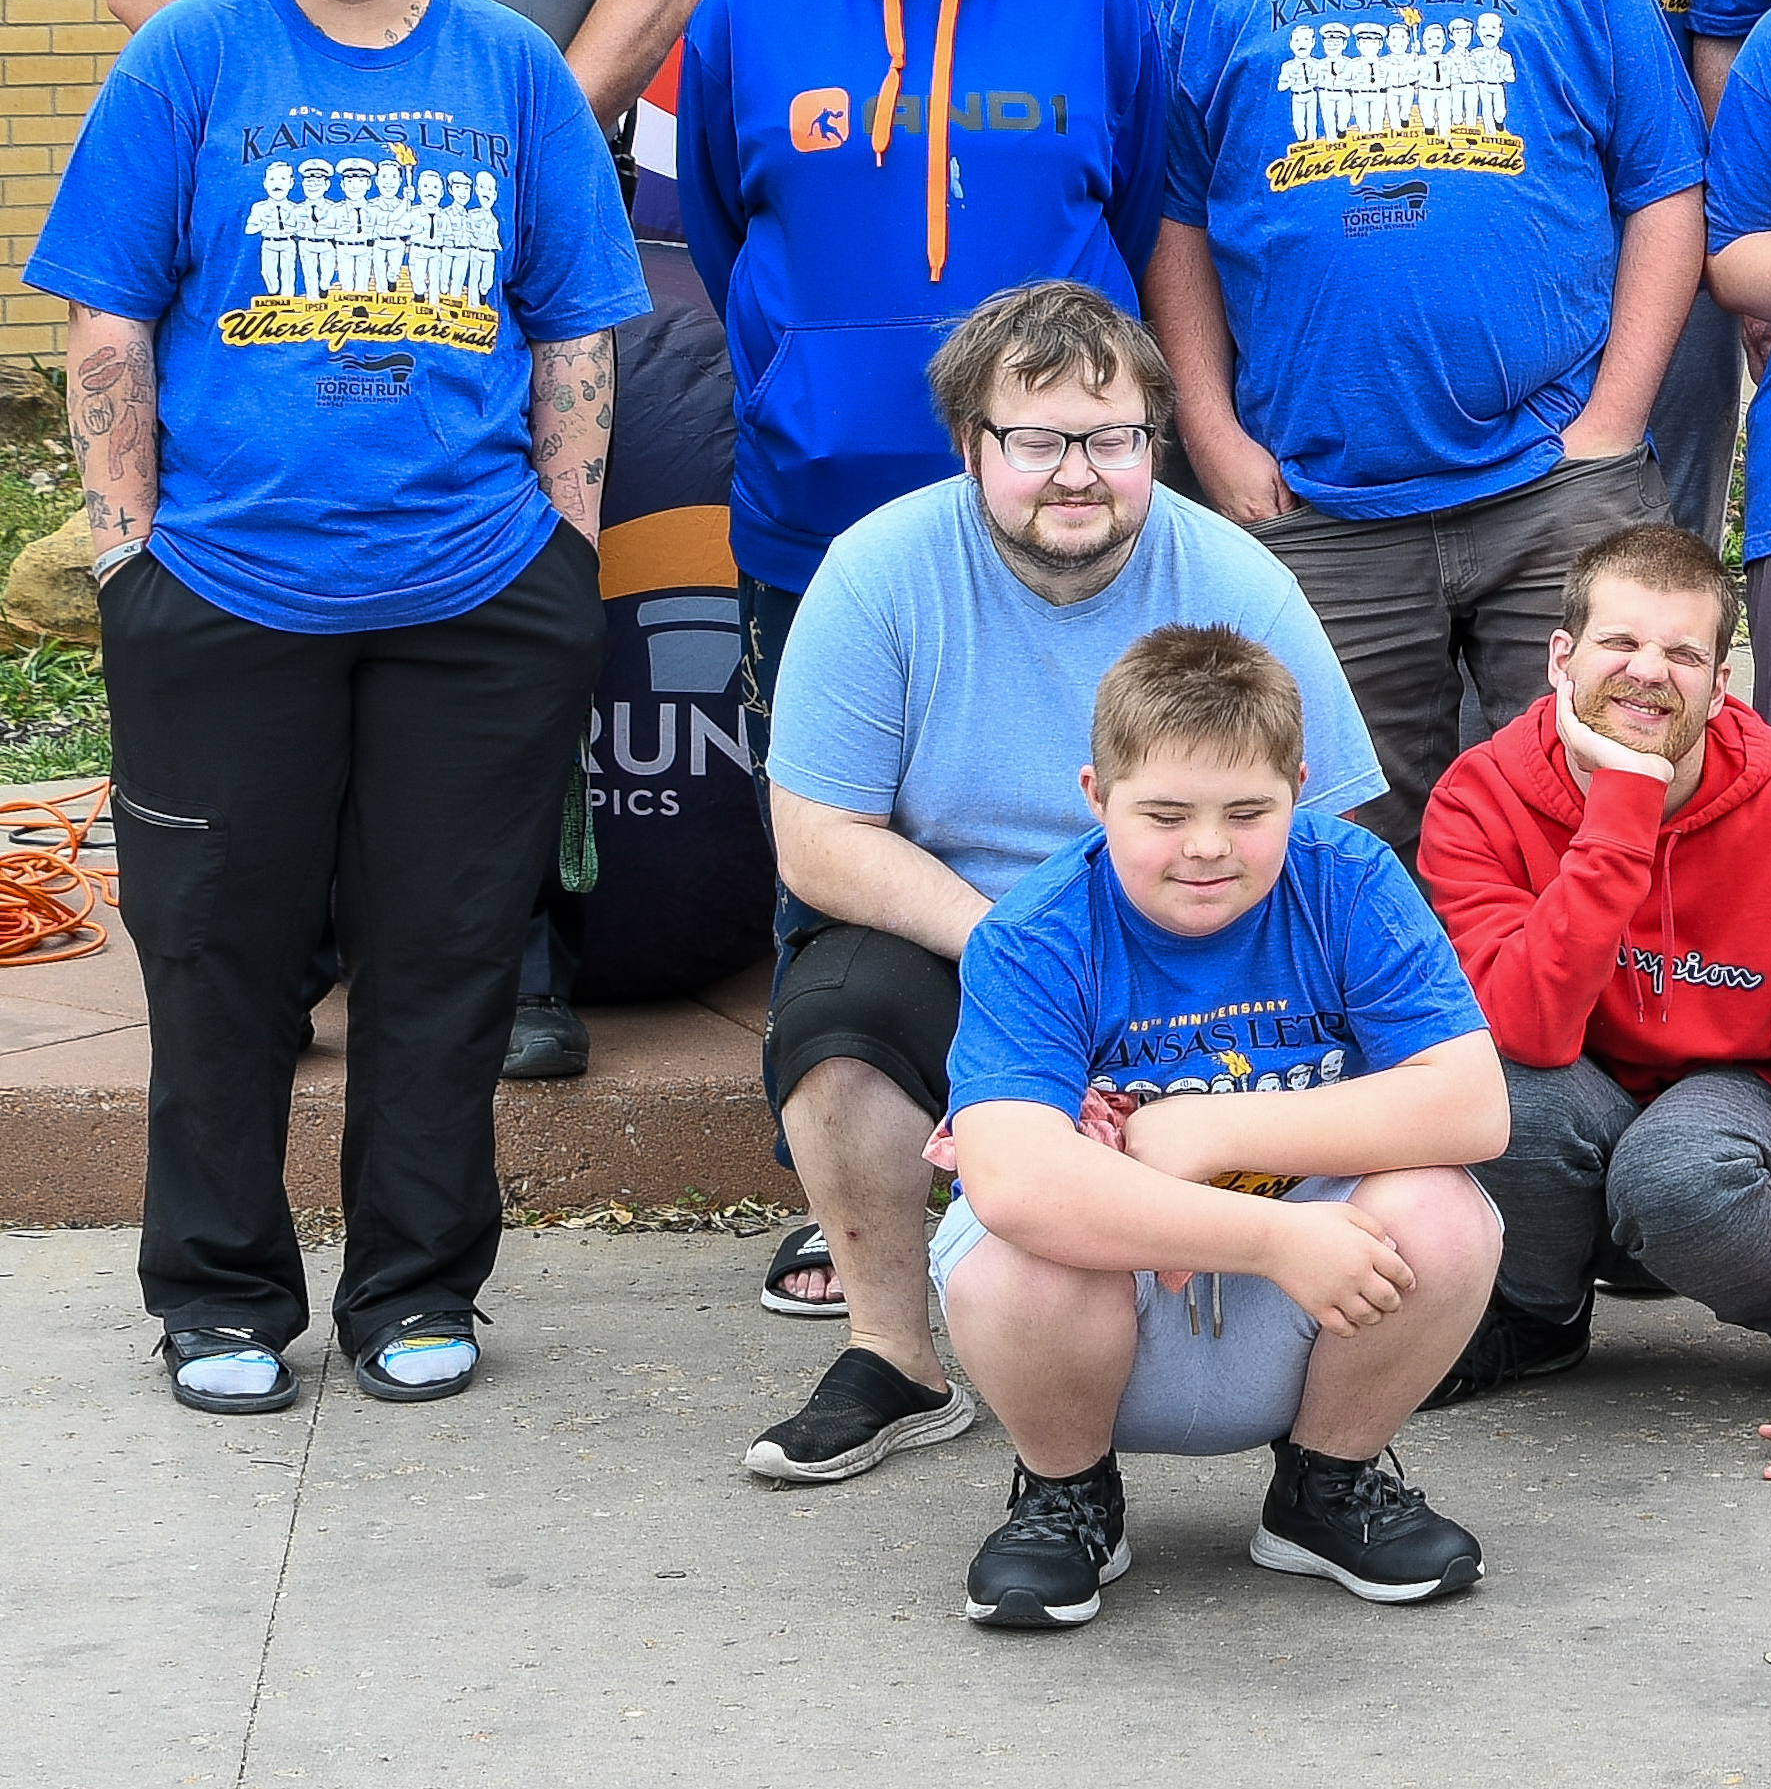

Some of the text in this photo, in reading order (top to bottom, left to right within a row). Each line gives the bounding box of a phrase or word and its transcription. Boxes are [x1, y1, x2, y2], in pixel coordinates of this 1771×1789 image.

[330, 110, 454, 123] ANNIVERSARY
[242, 121, 510, 178] KANSAS LETR
[1271, 143, 1525, 186] Where legends are made
[1341, 210, 1426, 227] TORCH RUN
[222, 312, 314, 341] Where
[319, 311, 407, 345] legends
[414, 322, 451, 340] are
[316, 382, 411, 396] TORCH RUN
[1168, 1000, 1288, 1028] ANNIVERSARY
[1249, 1012, 1346, 1049] LETR
